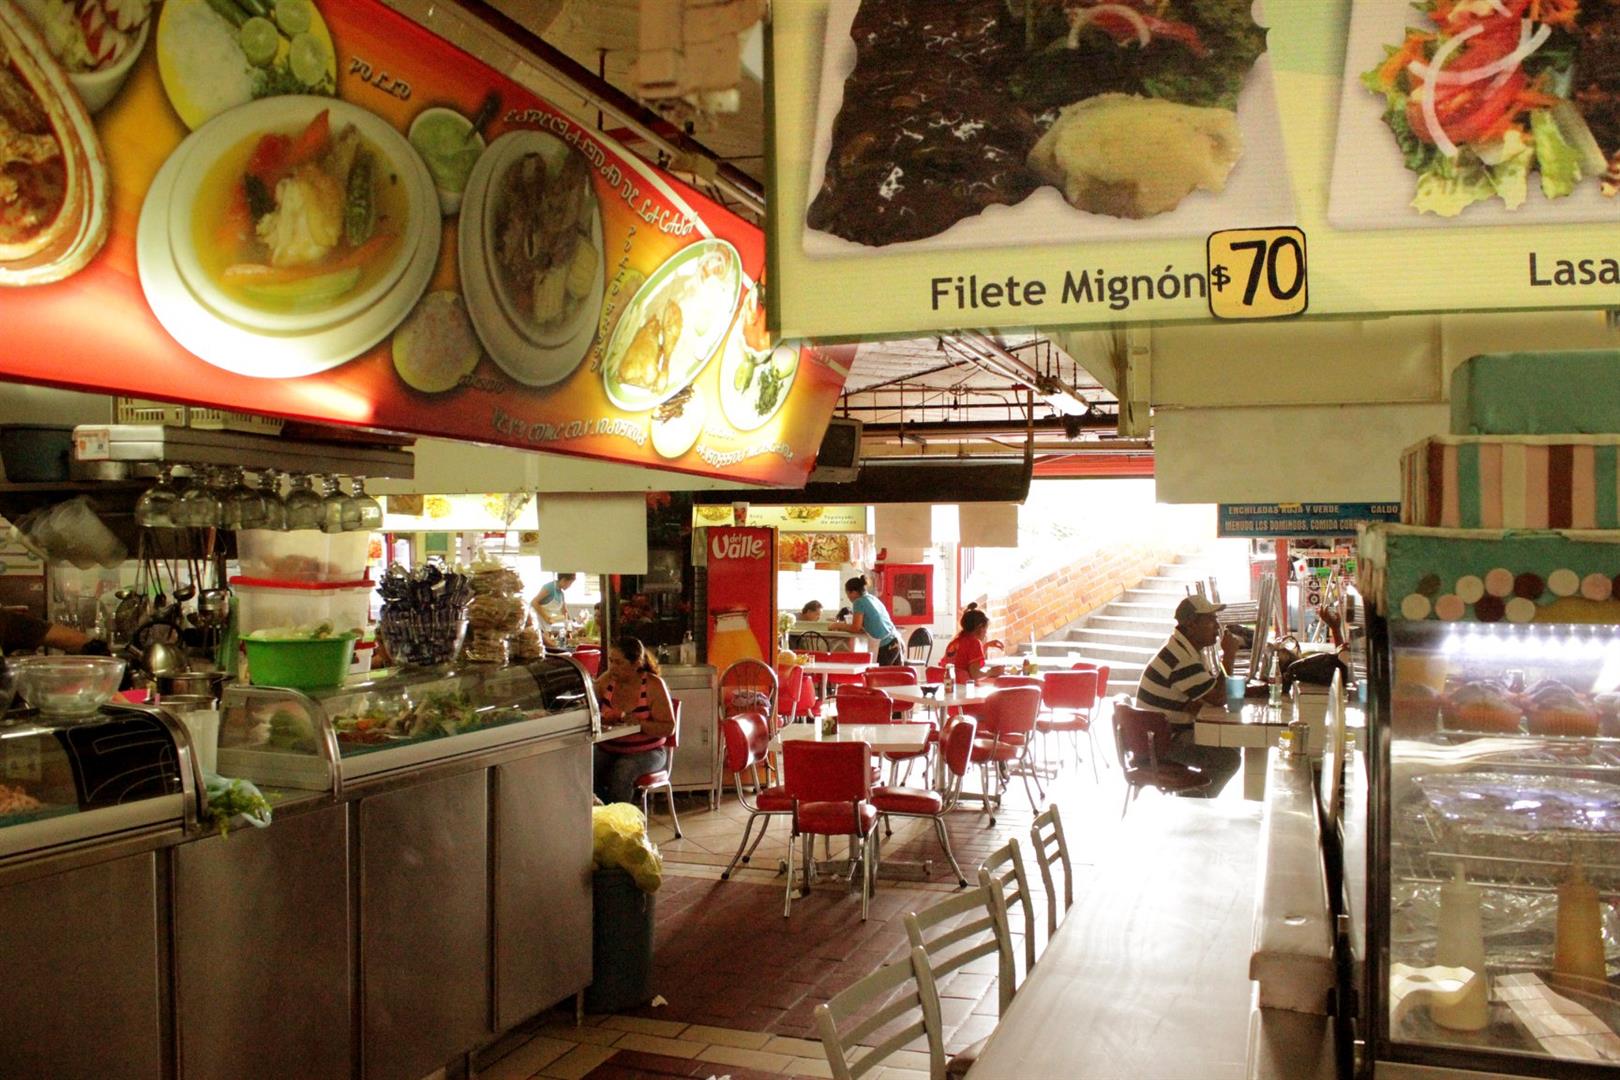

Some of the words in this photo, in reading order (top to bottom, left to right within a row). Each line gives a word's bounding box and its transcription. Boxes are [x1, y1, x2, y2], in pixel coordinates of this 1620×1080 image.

[350, 55, 411, 100] POLLO
[504, 109, 621, 187] ESPECIALIDAD
[620, 179, 640, 208] DE
[639, 199, 660, 224] LA
[659, 210, 698, 236] CASA
[931, 275, 1046, 310] Filete
[1061, 264, 1206, 310] Mignón
[1211, 236, 1304, 306] $70
[1529, 252, 1620, 287] Lasa
[1225, 520, 1254, 531] MENUDO
[1256, 520, 1269, 530] LOS
[1311, 519, 1338, 530] COMIDA
[1228, 505, 1279, 514] ENCHILADAS
[1313, 504, 1339, 513] VERDE
[1371, 505, 1398, 513] CALDO
[712, 534, 764, 559] Valle
